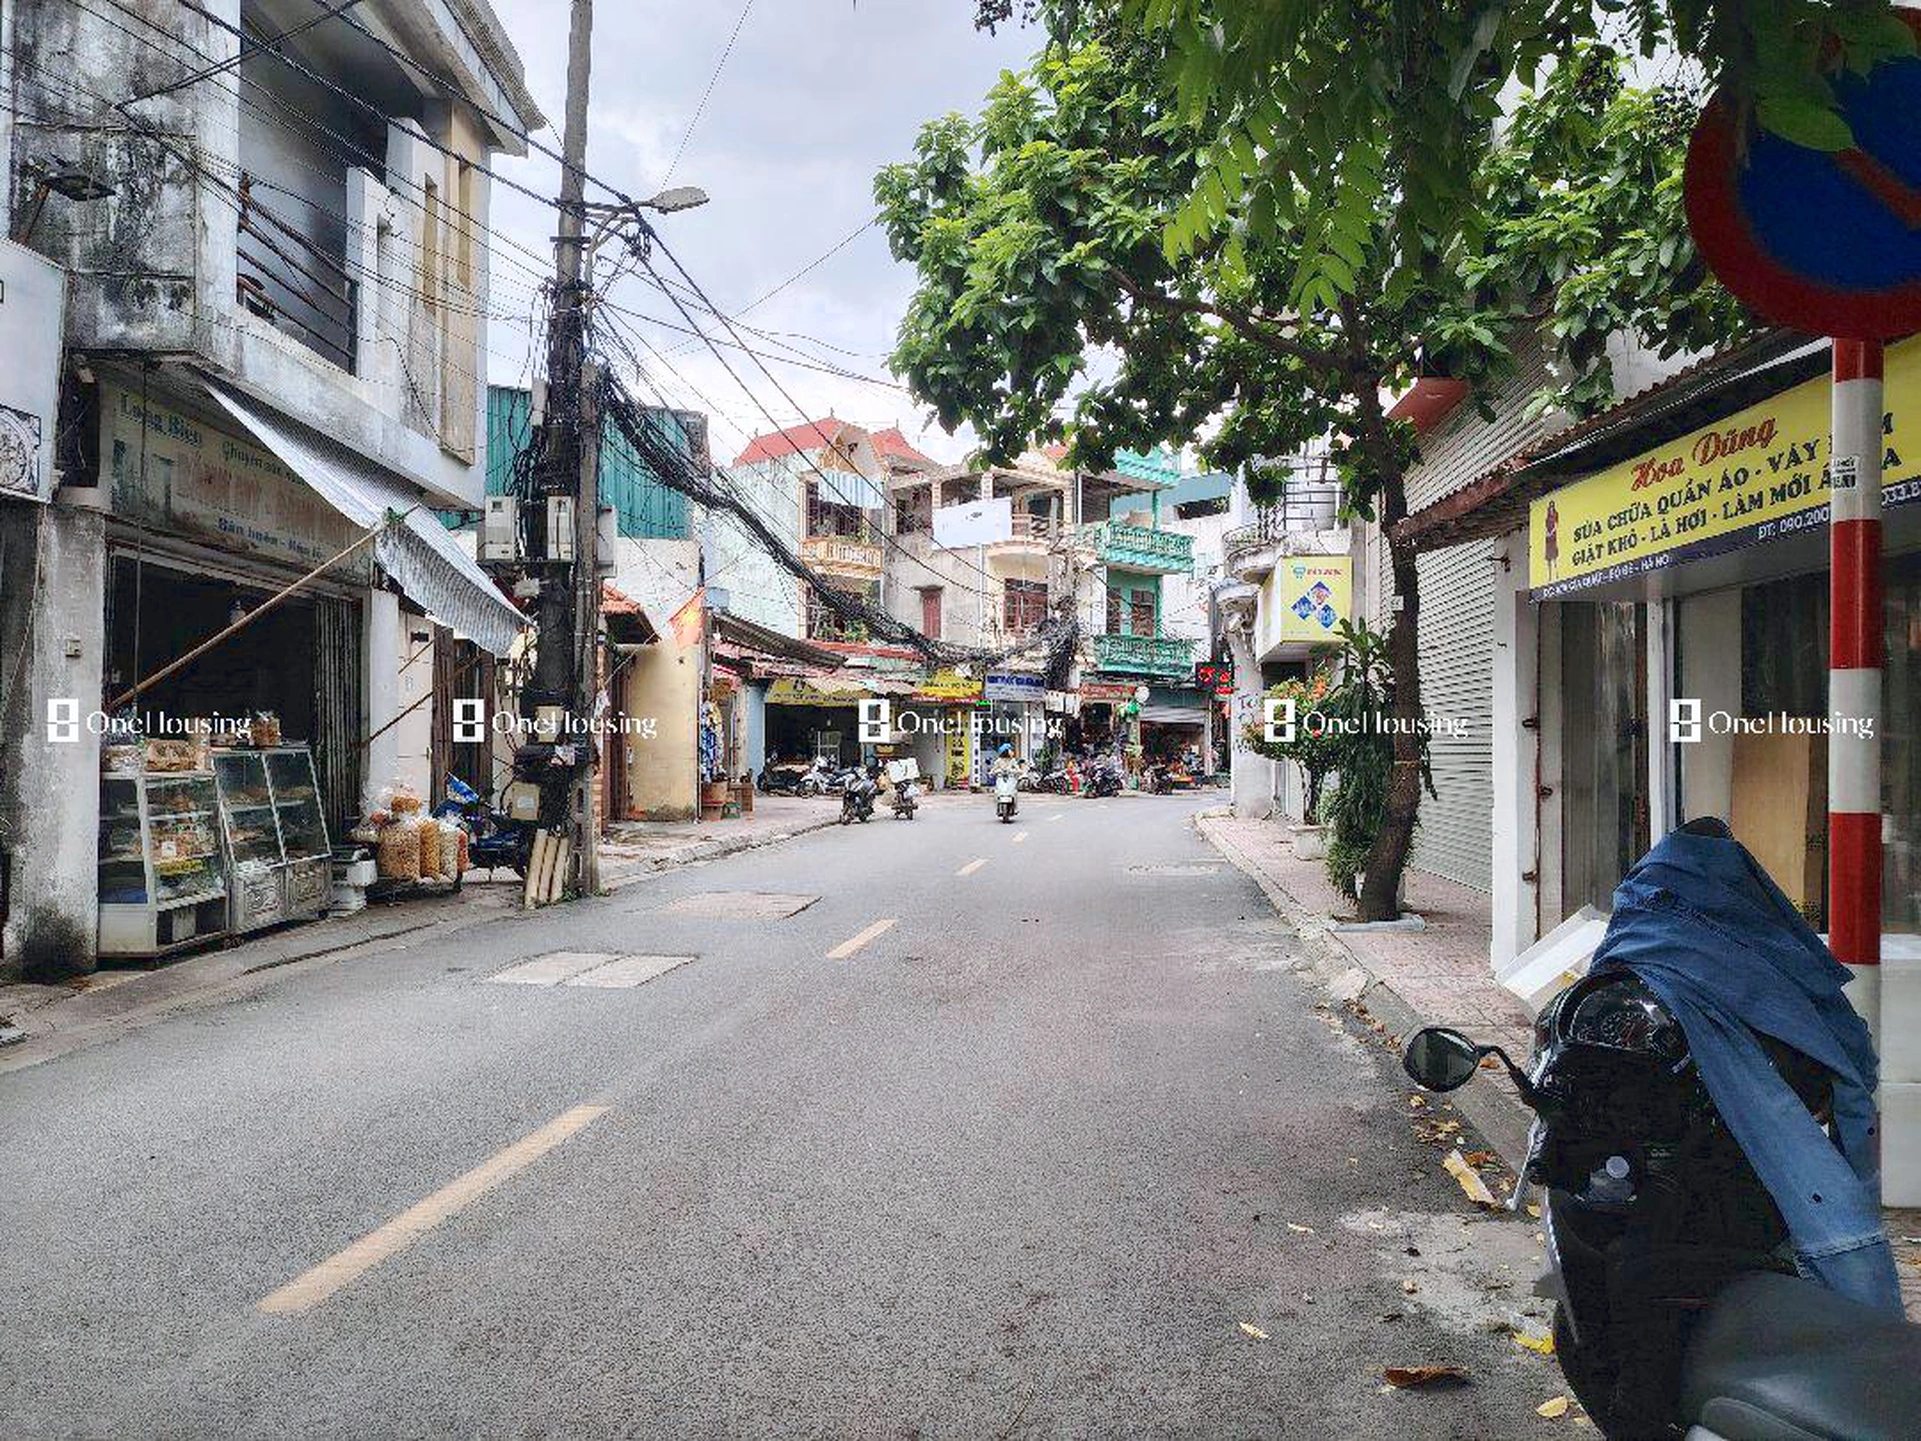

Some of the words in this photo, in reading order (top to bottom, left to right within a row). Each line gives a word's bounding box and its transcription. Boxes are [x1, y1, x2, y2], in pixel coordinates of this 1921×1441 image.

[1631, 457, 1686, 492] Hoa
[1692, 417, 1780, 467] Dũng
[1573, 519, 1603, 544] SỬA
[1606, 501, 1653, 531] CHỮA
[1657, 478, 1712, 516] QUẦN
[1718, 466, 1750, 494] ÁO
[1607, 529, 1639, 556] KHÔ
[1650, 517, 1672, 544] LÀ
[1675, 508, 1708, 536] HƠI
[1721, 490, 1764, 524] LÀM
[1769, 471, 1812, 506] MỚI
